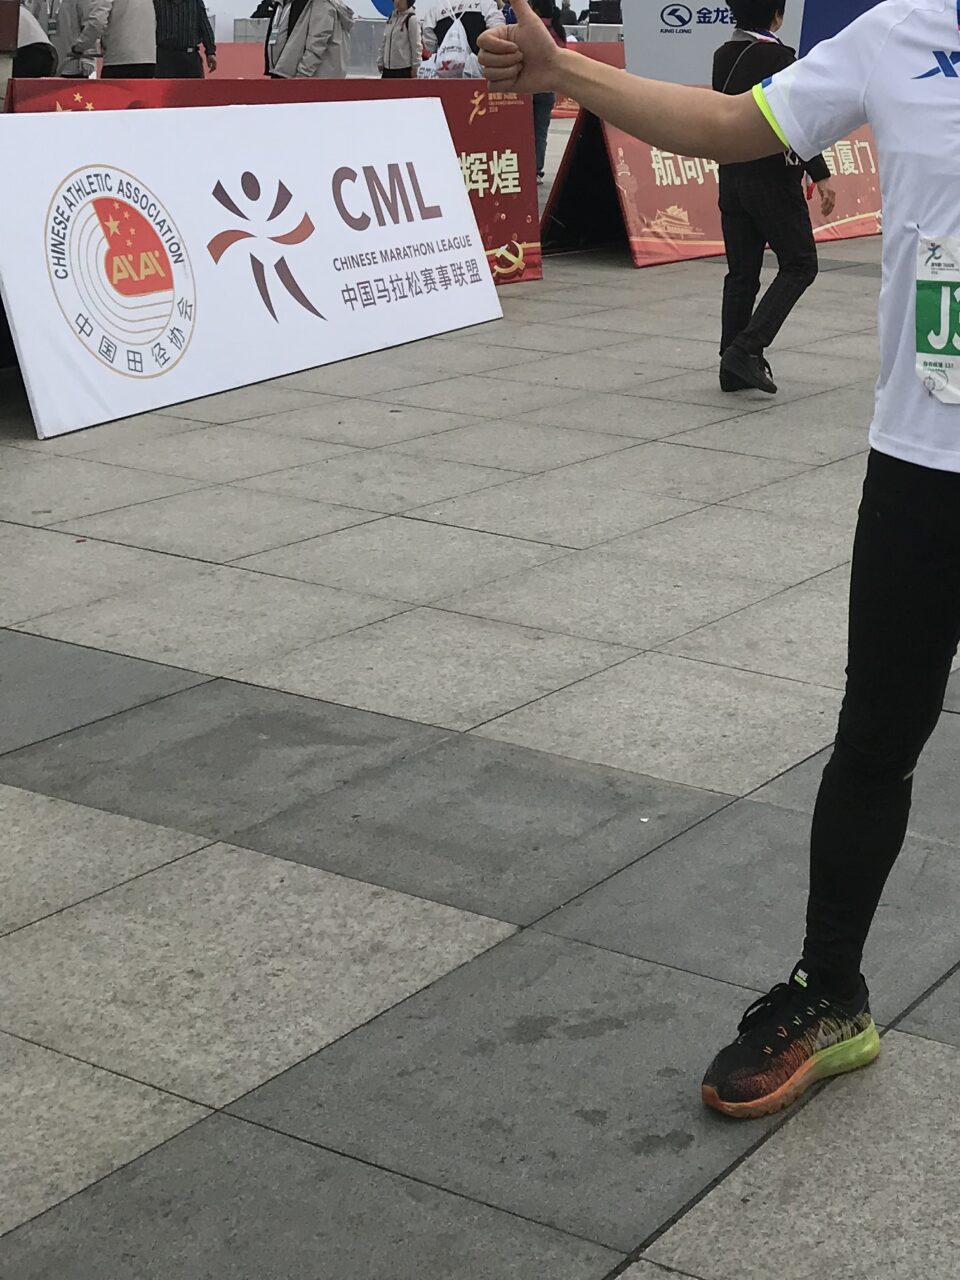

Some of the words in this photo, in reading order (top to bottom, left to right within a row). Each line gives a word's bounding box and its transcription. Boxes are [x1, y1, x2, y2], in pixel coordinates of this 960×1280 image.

[331, 161, 443, 231] CML
[458, 149, 522, 197] 辉煌
[51, 205, 71, 280] CHINESE
[64, 173, 113, 212] ATHLETIC
[117, 177, 186, 265] ASSOCIATION
[332, 249, 379, 272] CHINESE
[379, 241, 436, 264] MARATHON
[435, 234, 473, 253] LEAGUE
[341, 258, 483, 312] 中国马拉松赛事联盟
[74, 296, 194, 373] 中国田径协会
